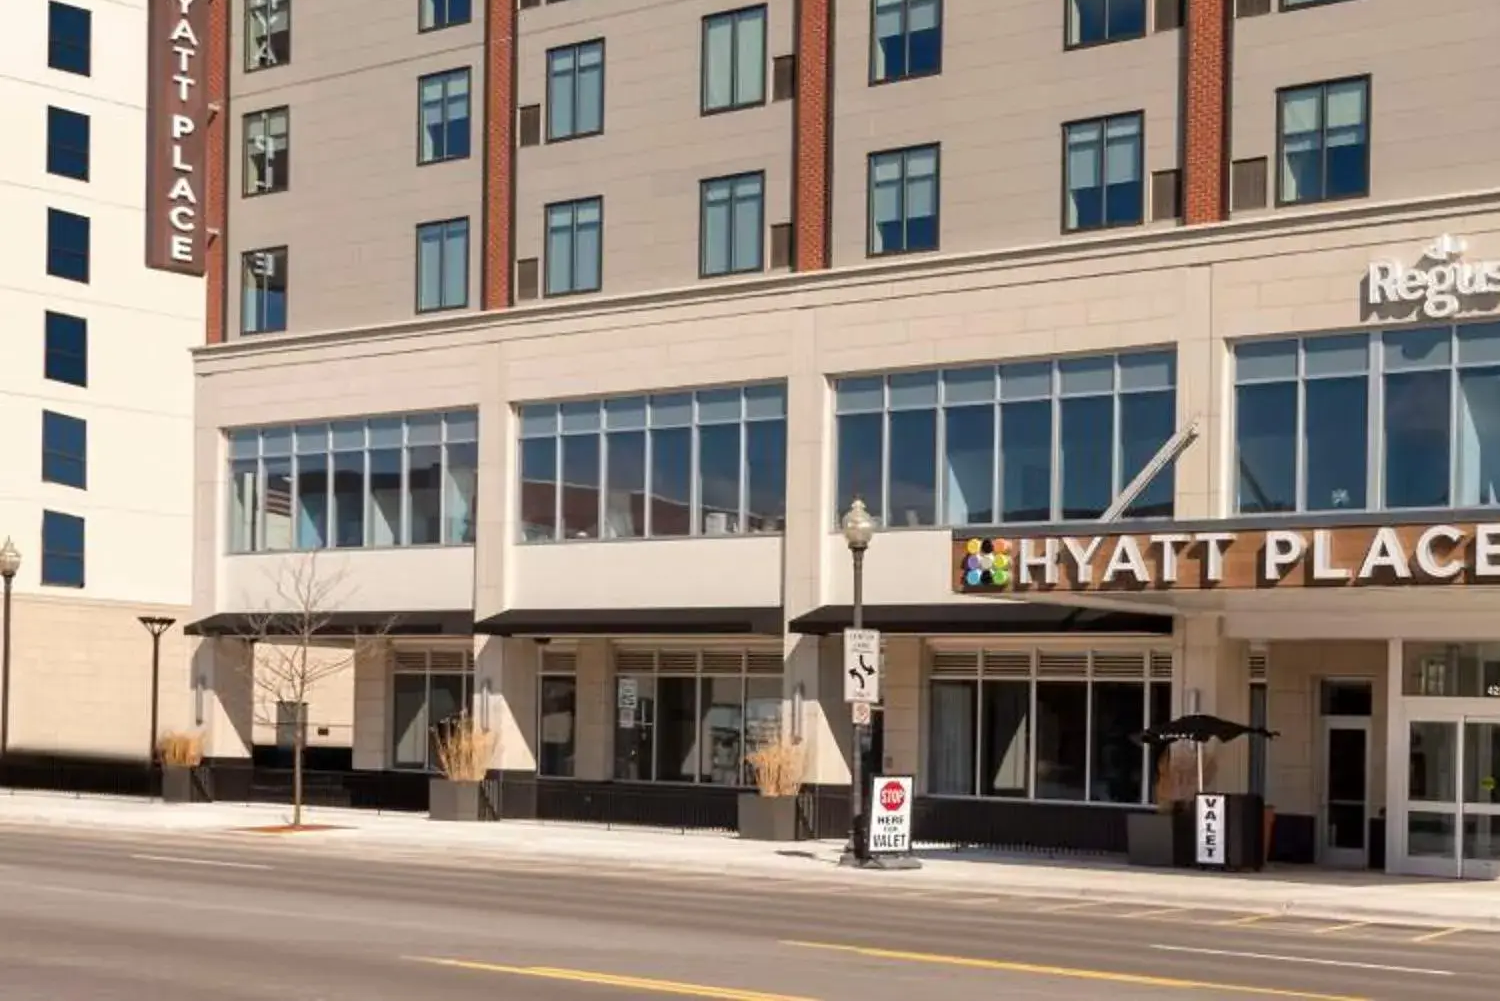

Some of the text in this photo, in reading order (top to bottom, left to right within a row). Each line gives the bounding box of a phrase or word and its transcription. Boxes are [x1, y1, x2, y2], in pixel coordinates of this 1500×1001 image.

[169, 114, 196, 262] PLACE
[1019, 532, 1237, 585] HYATT
[881, 788, 904, 804] STOP
[877, 814, 904, 825] HERE
[1204, 798, 1217, 858] VALET
[873, 834, 906, 848] VALET
